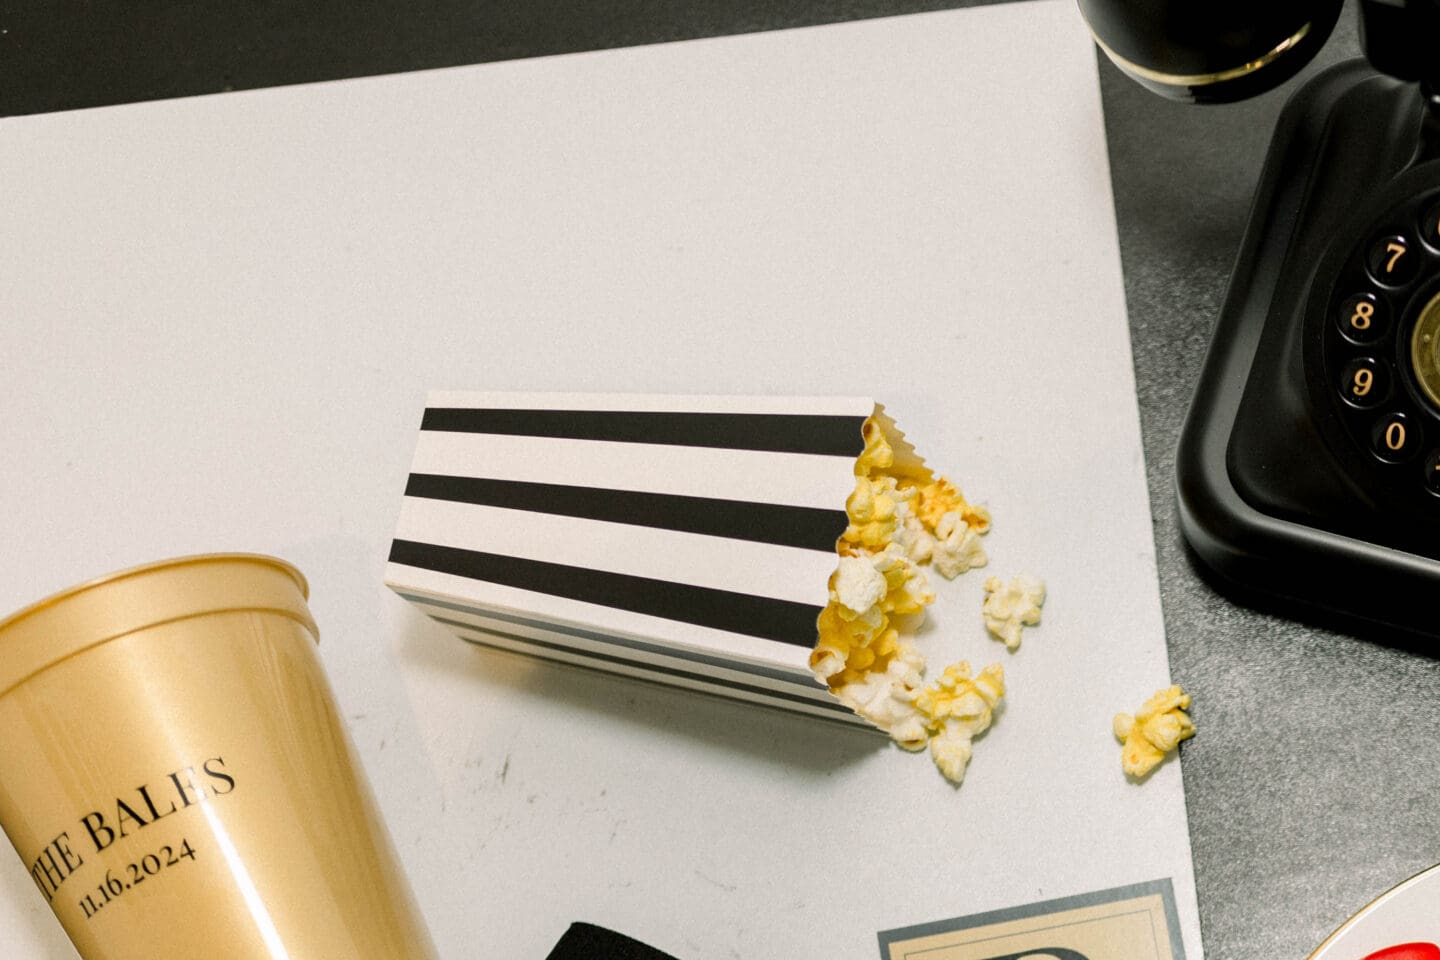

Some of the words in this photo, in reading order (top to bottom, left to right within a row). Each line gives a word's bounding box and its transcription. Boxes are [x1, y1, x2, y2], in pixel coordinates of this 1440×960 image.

[1386, 243, 1407, 273] 7
[1350, 301, 1375, 330] 8
[1352, 368, 1374, 396] 9
[1385, 422, 1406, 451] 0
[31, 831, 85, 901] THE
[79, 756, 236, 853] BALES
[79, 838, 196, 919] 11.16.2024
